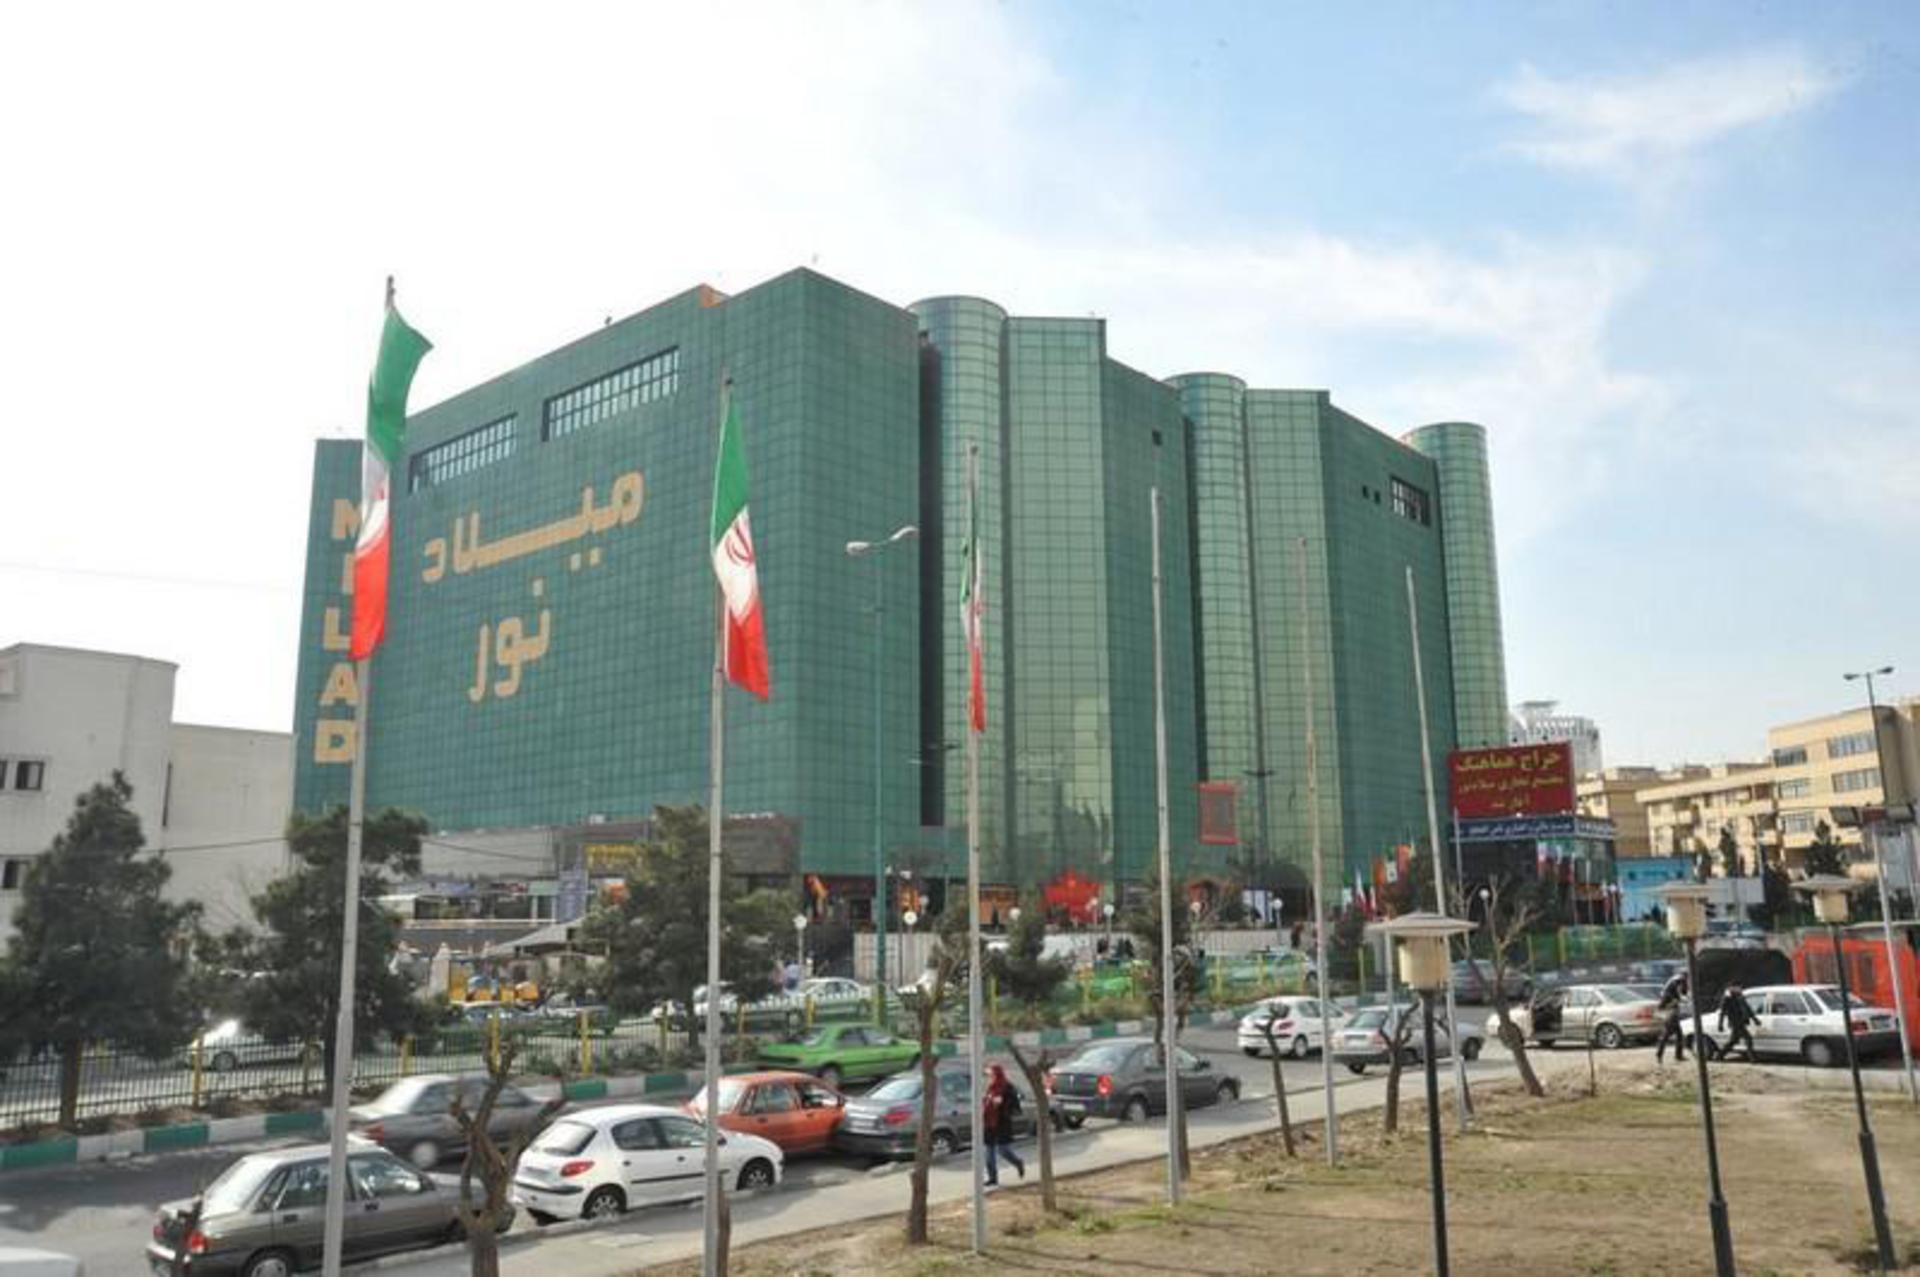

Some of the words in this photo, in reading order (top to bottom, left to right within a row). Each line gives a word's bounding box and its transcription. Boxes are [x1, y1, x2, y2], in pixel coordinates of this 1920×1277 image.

[422, 471, 644, 583] میلاد
[314, 498, 361, 763] MILAD
[467, 578, 551, 702] نور
[1518, 749, 1560, 772] حراج
